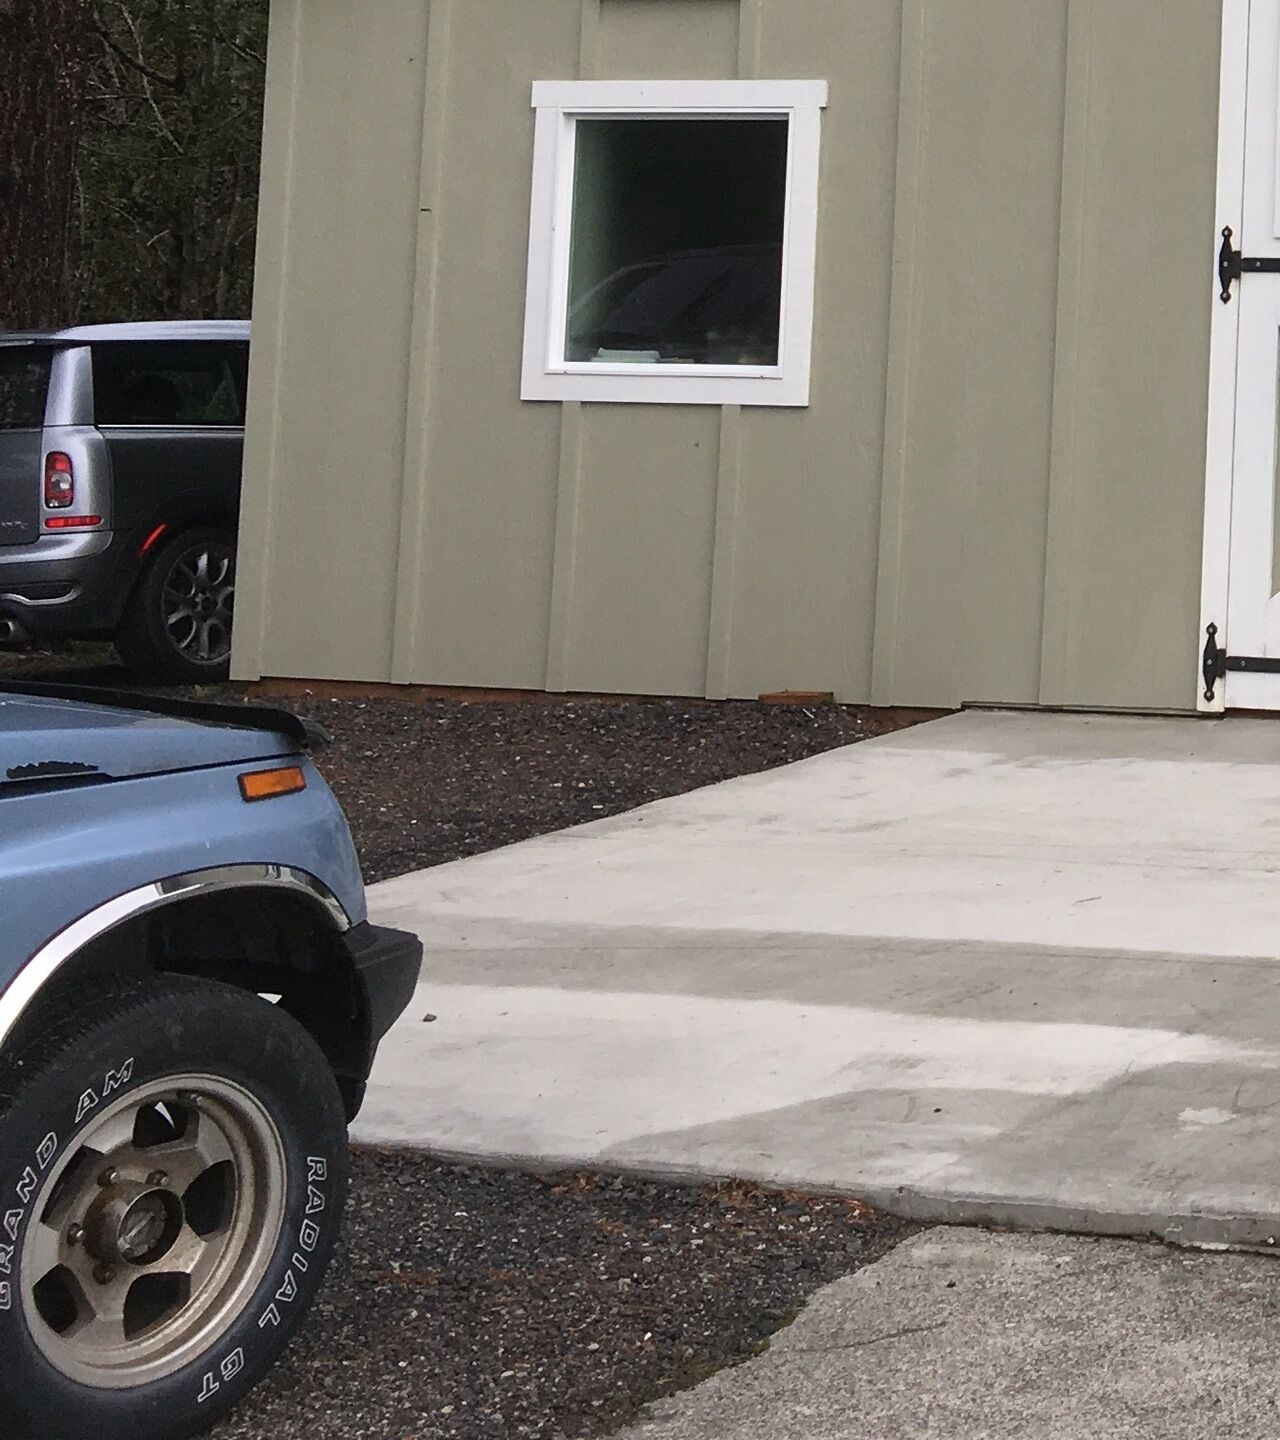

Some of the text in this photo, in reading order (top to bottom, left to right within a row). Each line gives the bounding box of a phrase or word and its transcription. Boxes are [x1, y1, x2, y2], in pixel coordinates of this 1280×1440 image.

[74, 1057, 135, 1124] AM
[198, 1156, 328, 1403] RADIAL GT
